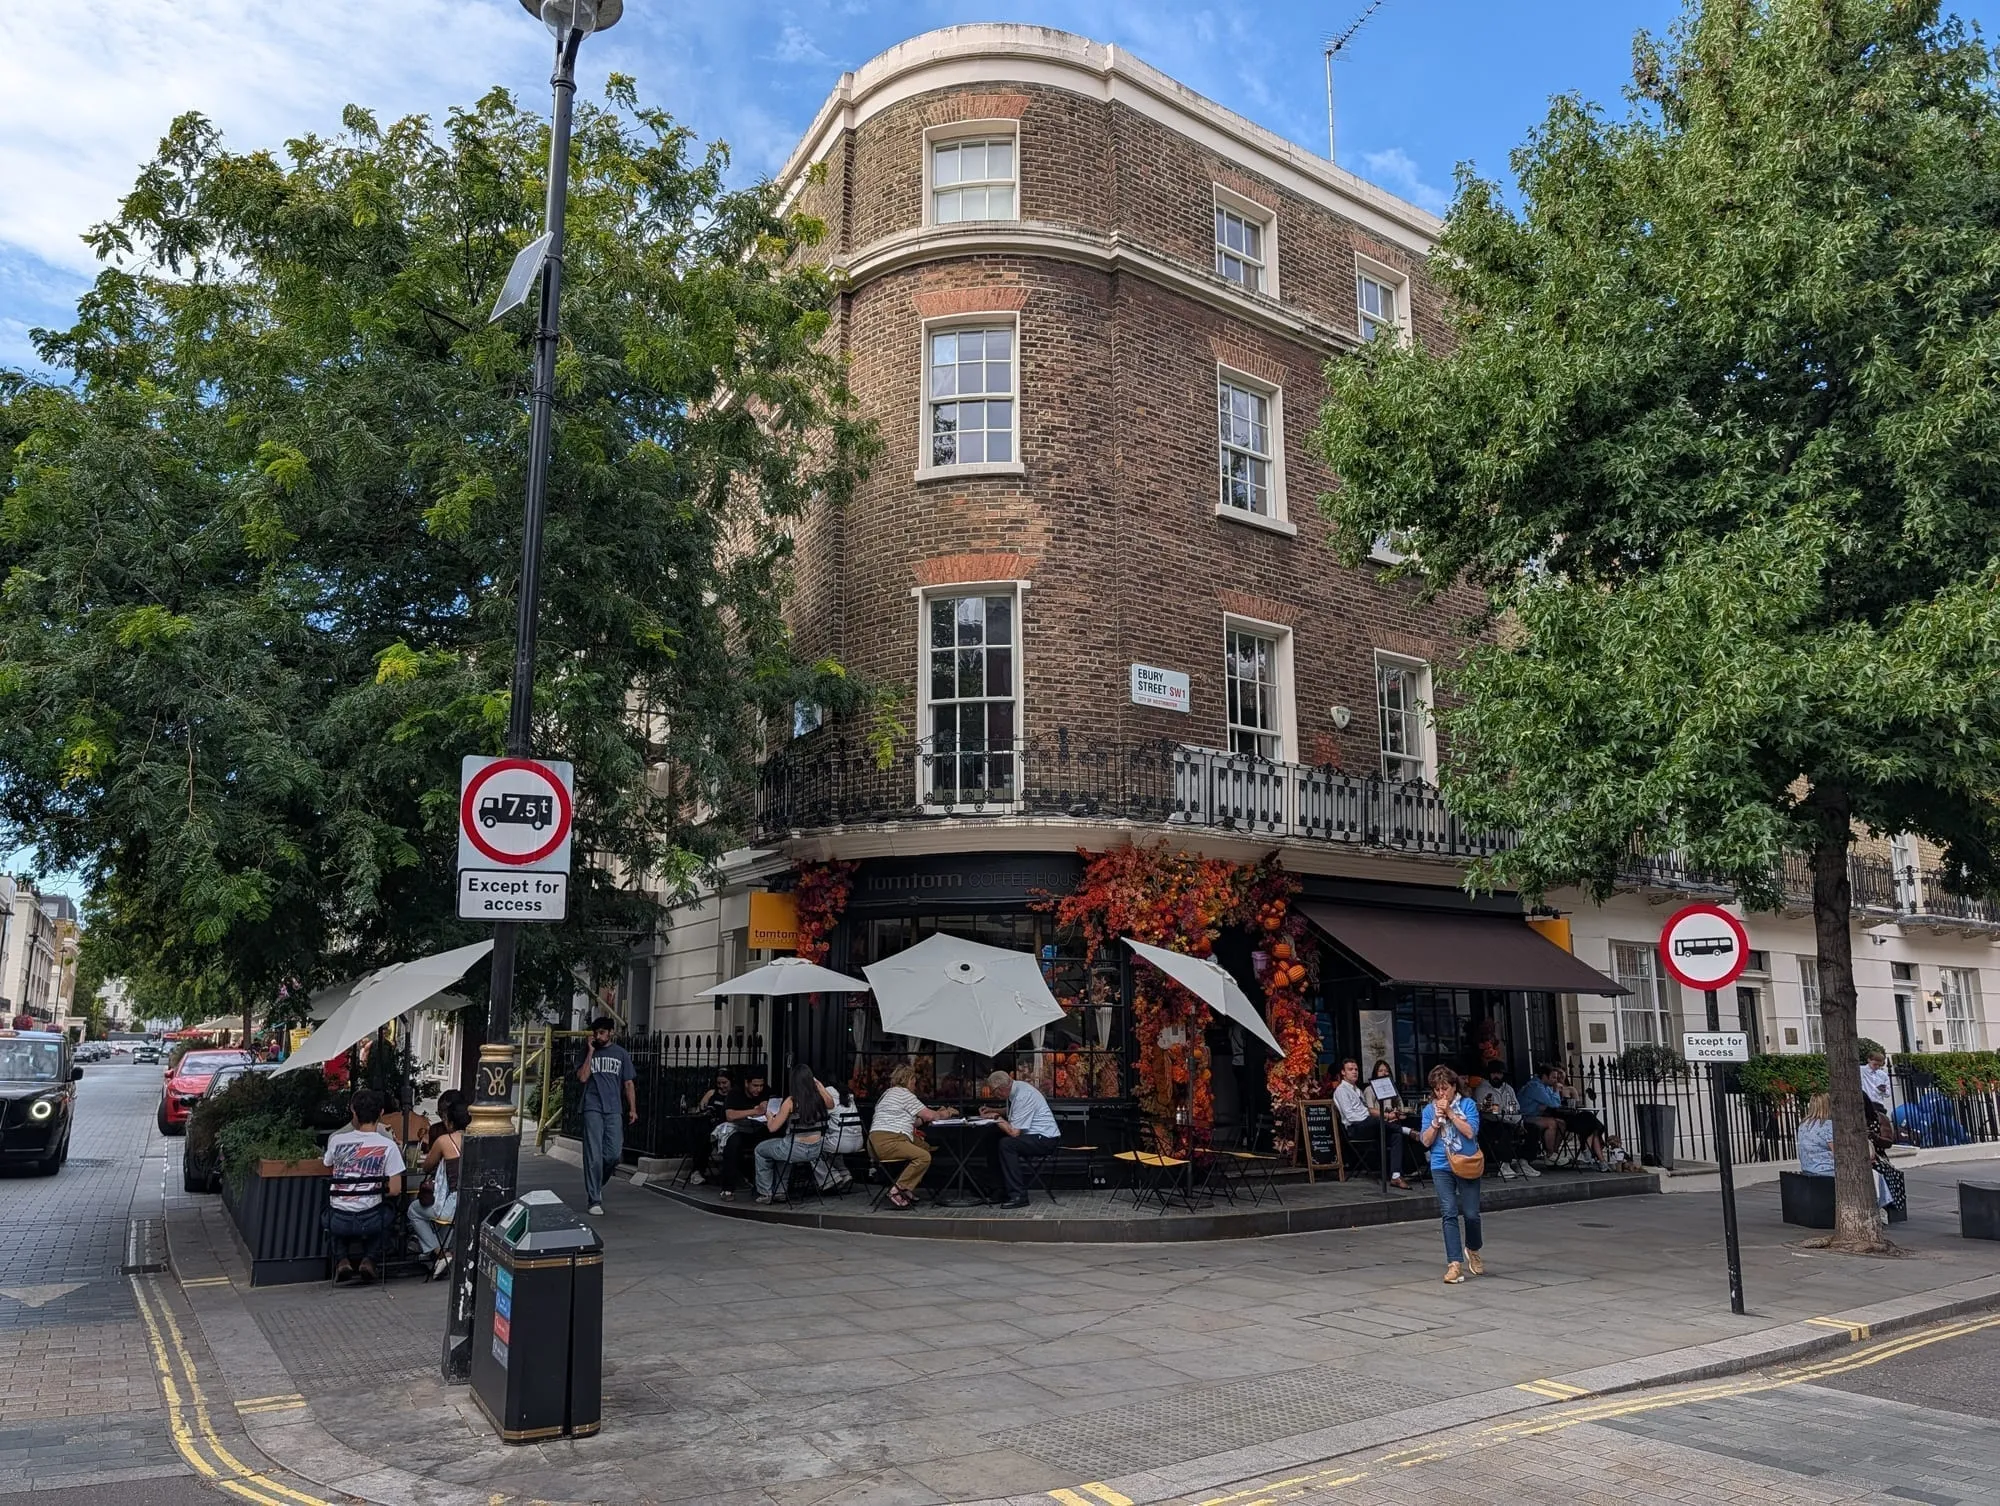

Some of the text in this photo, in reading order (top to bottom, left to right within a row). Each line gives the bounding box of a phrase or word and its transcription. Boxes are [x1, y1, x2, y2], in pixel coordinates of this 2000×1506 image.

[1138, 669, 1163, 682] EBURY
[1138, 681, 1186, 699] STREET SW1
[468, 878, 560, 895] Except for
[867, 872, 963, 891] tomtom
[968, 872, 1034, 887] COFFEE
[484, 899, 542, 911] access
[755, 929, 798, 939] tomtom
[1687, 1036, 1743, 1047] Except for
[1698, 1049, 1734, 1057] access
